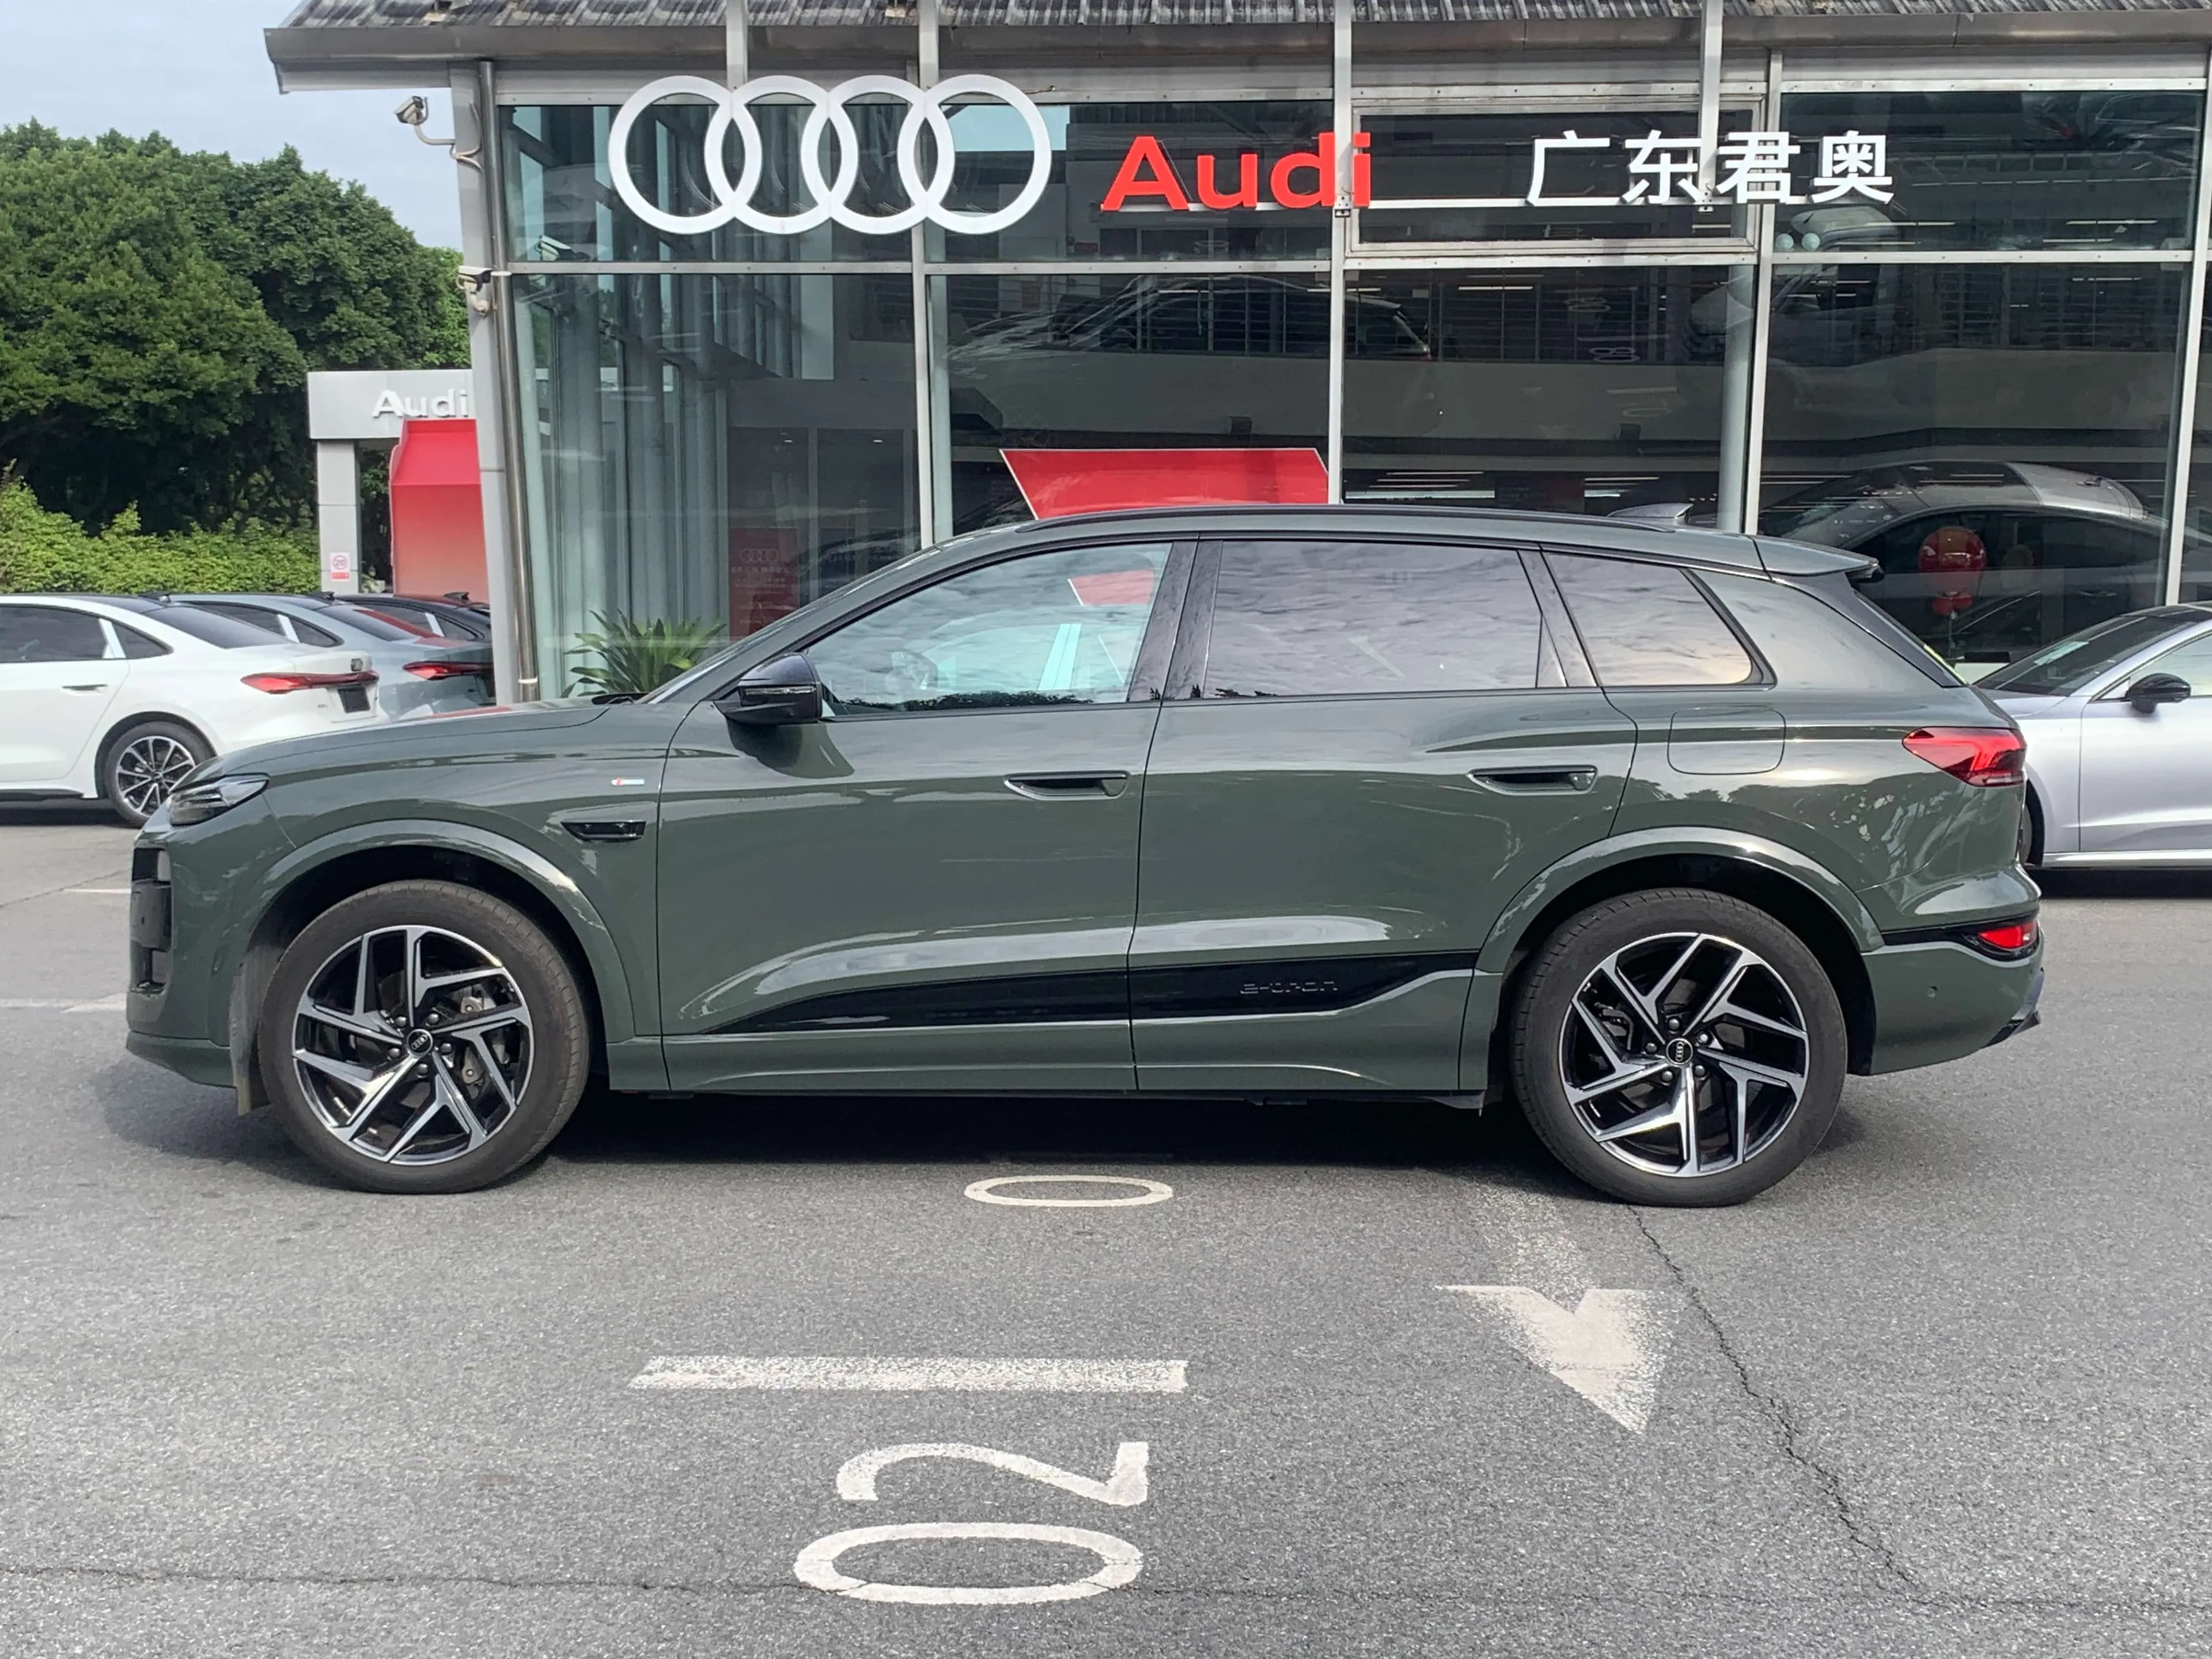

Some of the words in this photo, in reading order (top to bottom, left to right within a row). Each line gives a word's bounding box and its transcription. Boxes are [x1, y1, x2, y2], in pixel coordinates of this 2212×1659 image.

[1100, 132, 1372, 211] Audi
[1525, 130, 1895, 206] 广东君奥
[372, 389, 469, 418] Audi
